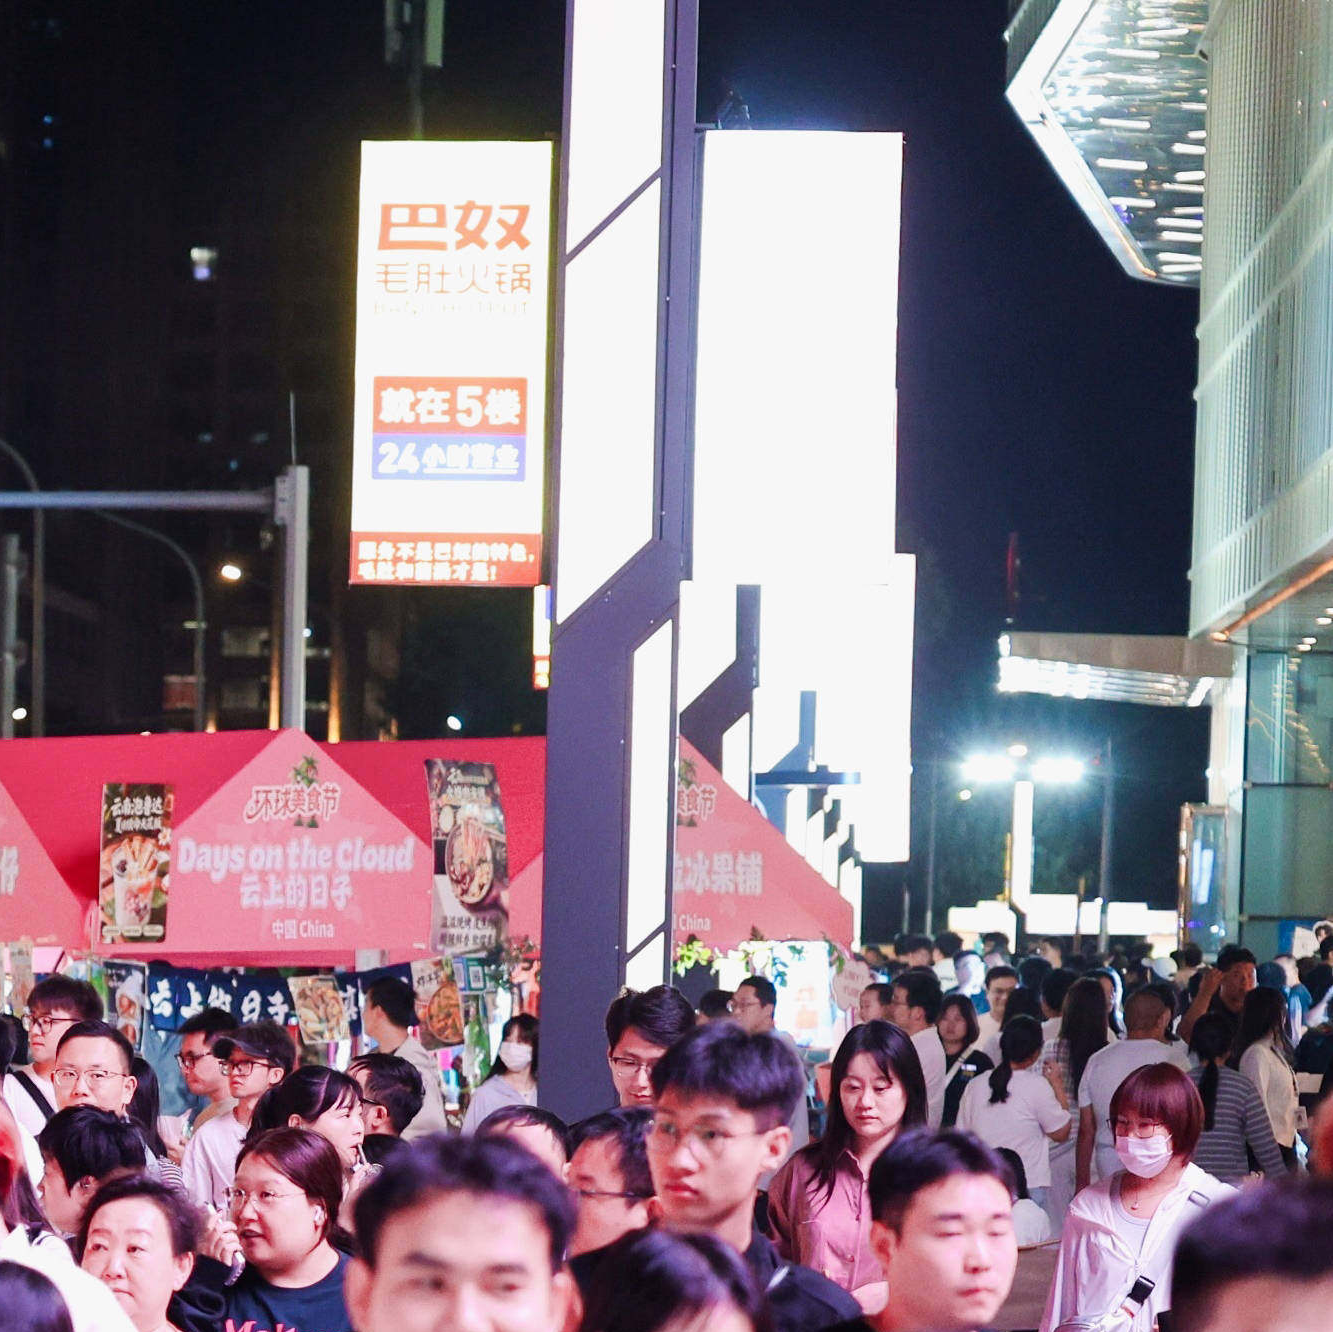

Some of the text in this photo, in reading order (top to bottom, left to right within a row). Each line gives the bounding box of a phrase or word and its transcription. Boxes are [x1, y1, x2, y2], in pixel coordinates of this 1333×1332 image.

[378, 200, 531, 251] 巴奴
[375, 262, 532, 294] 毛肚火锅
[379, 386, 521, 427] 就在5楼
[244, 782, 341, 824] 环球美食节
[177, 836, 415, 882] Days on the Cloud
[239, 873, 354, 911] 云上的日子
[272, 918, 335, 940] 中国 China
[679, 912, 712, 932] China
